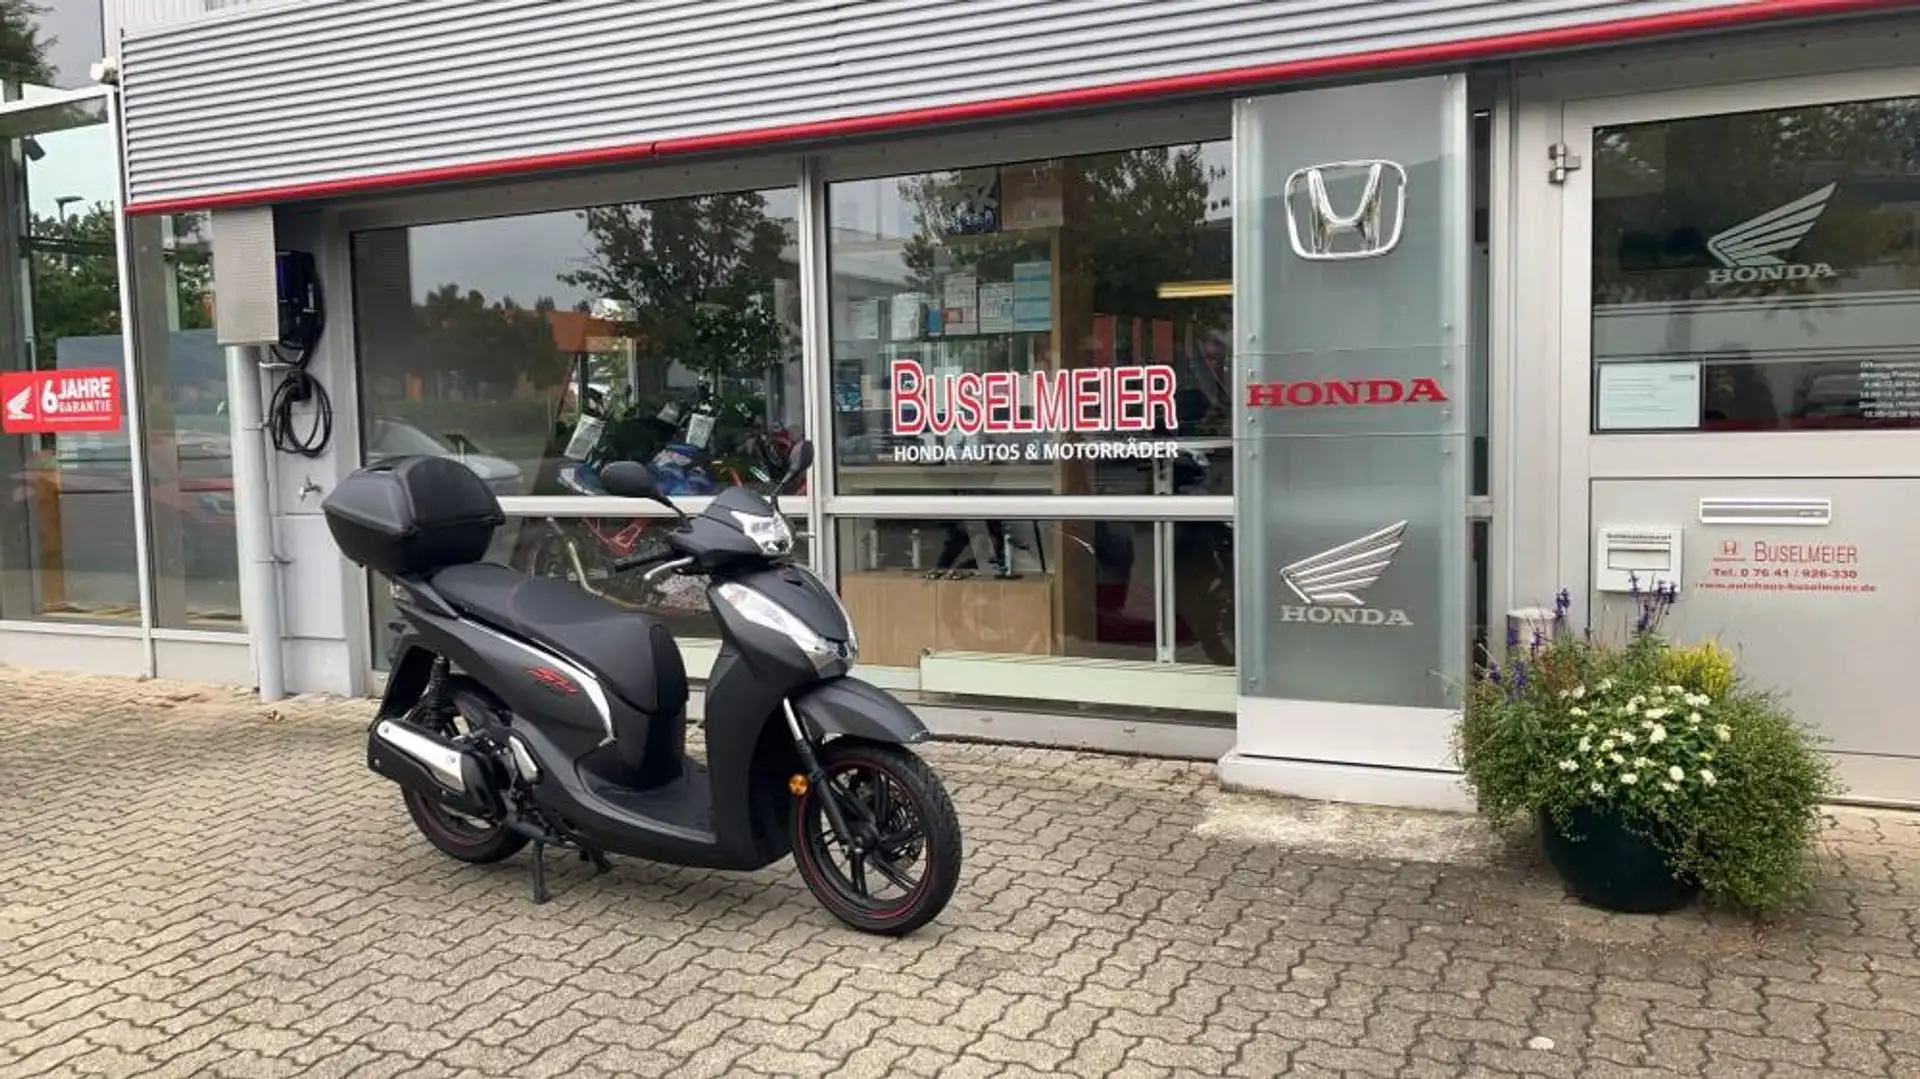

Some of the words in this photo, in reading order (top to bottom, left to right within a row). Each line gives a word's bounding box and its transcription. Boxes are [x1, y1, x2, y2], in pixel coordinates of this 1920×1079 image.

[1705, 262, 1838, 284] HONDA
[42, 379, 58, 413] 6
[58, 376, 113, 399] JAHRE
[891, 359, 1178, 435] BUSELMEIER
[1246, 377, 1449, 407] HONDA
[59, 399, 113, 413] GARANTIE
[893, 445, 956, 462] HONDA
[962, 444, 1019, 461] AUTOS
[1025, 444, 1038, 460] &
[1043, 438, 1179, 461] MOTORRÄDER
[1754, 541, 1858, 563] BUSELMEIER
[1279, 605, 1414, 626] HONDA
